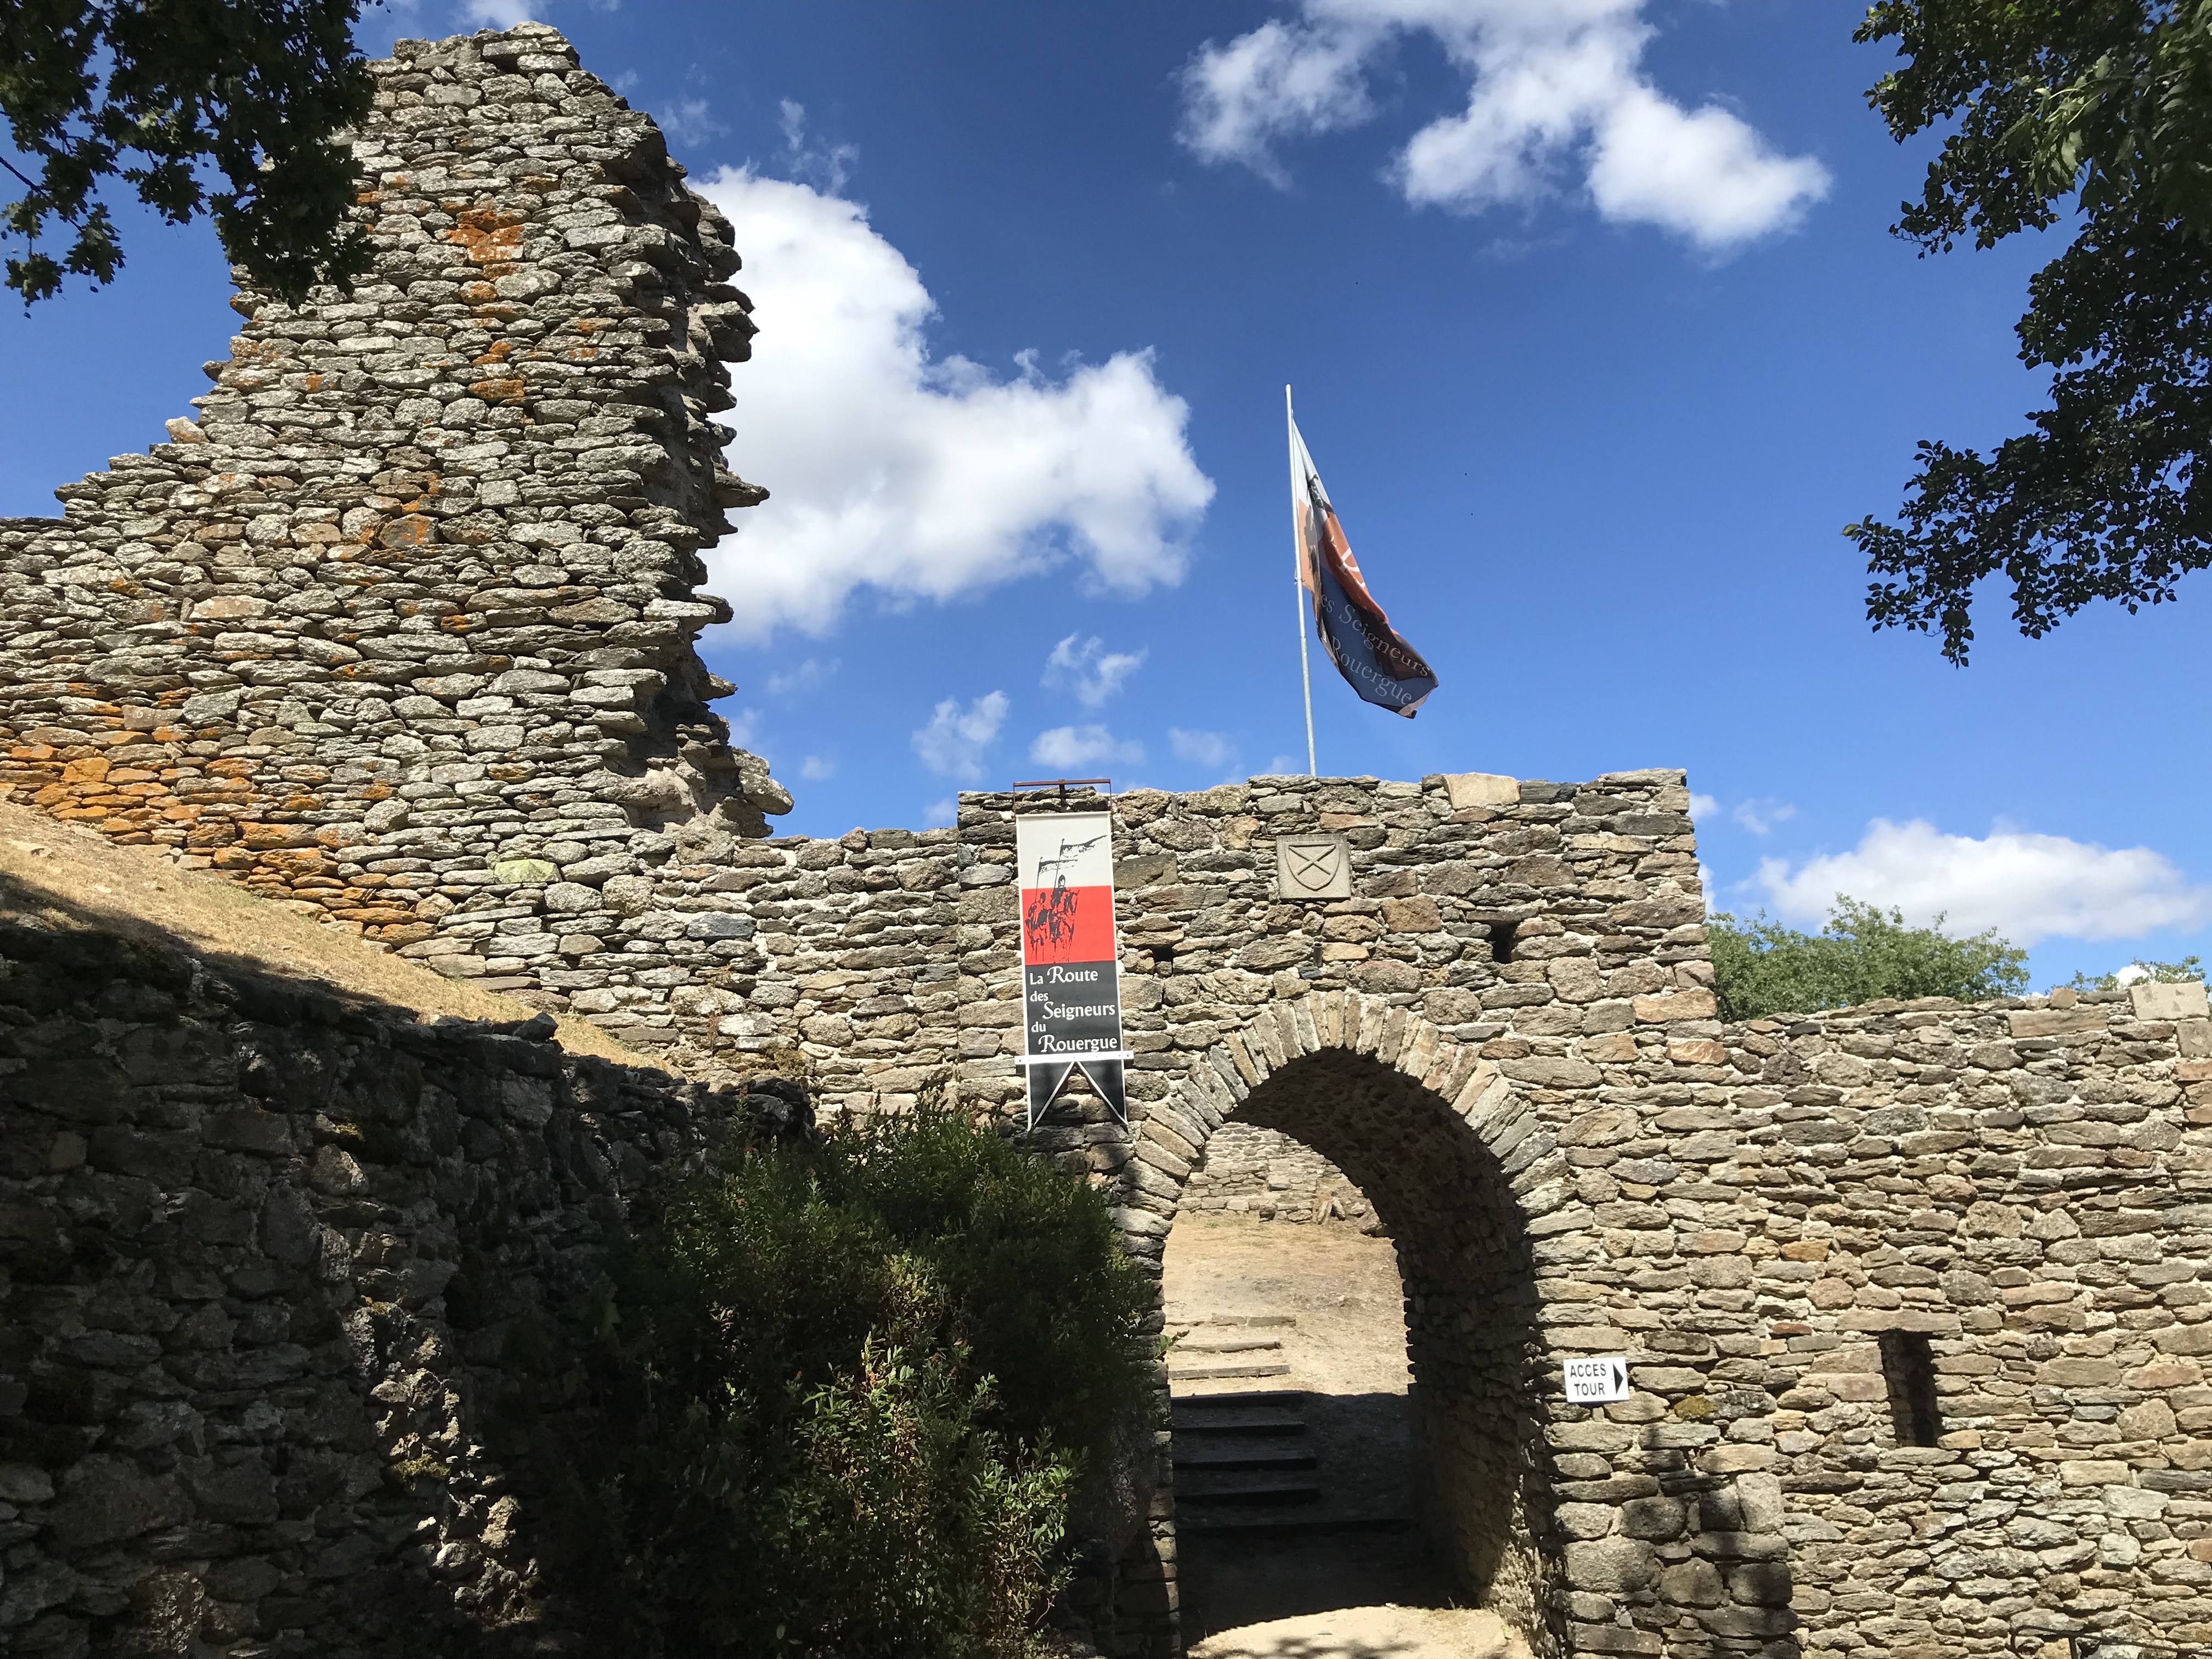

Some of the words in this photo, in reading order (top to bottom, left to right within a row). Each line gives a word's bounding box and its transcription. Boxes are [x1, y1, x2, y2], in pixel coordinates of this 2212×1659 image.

[1321, 594, 1335, 613] es
[1339, 604, 1430, 677] Seigneurs
[1332, 635, 1412, 705] Rouergue
[1030, 973, 1043, 985] La
[1047, 966, 1098, 984] Route
[1030, 990, 1048, 1002] des
[1042, 1001, 1115, 1020] Seigneurs
[1031, 1021, 1046, 1032] du
[1038, 1034, 1118, 1052] Rouergue
[1570, 1363, 1606, 1378] ACCES
[1574, 1383, 1605, 1396] TOUR
